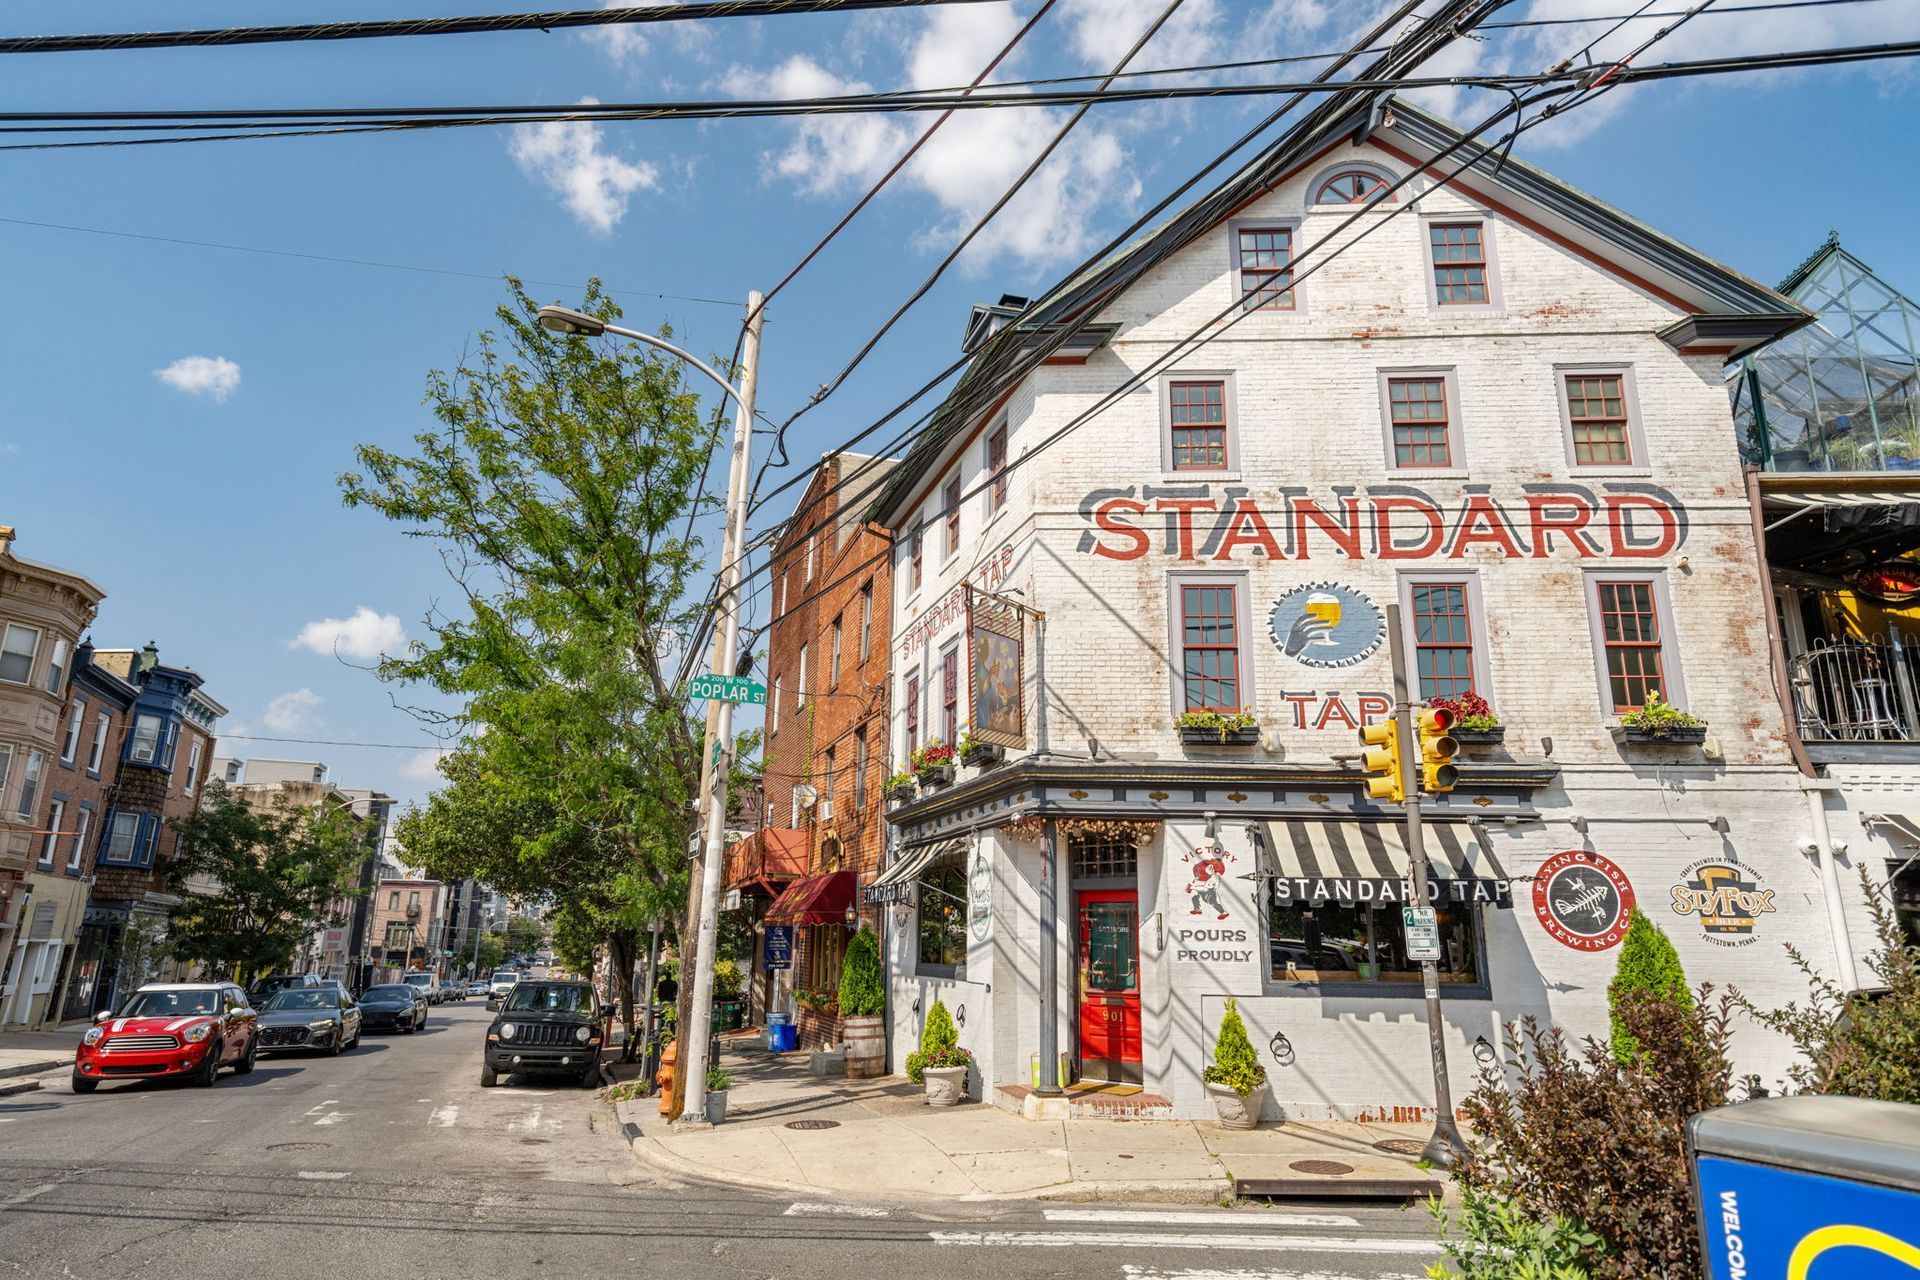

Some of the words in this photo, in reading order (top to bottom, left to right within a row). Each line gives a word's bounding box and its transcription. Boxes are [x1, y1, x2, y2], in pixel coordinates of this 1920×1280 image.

[1078, 483, 1688, 560] STANDARD
[980, 543, 1013, 592] TAP
[692, 682, 748, 701] POPLAR
[754, 692, 765, 702] ST
[1280, 690, 1393, 730] TAP
[1181, 846, 1237, 863] VICTORY
[1693, 857, 1715, 867] BREWED
[1594, 857, 1629, 892] FISH
[898, 881, 911, 899] TAP
[1452, 880, 1510, 900] TAP
[1404, 911, 1413, 925] 2
[1538, 906, 1617, 948] BREWING
[1715, 918, 1739, 926] BEER
[1179, 929, 1247, 942] POURS
[1177, 950, 1253, 962] PROUDLY
[1102, 1010, 1123, 1022] 901
